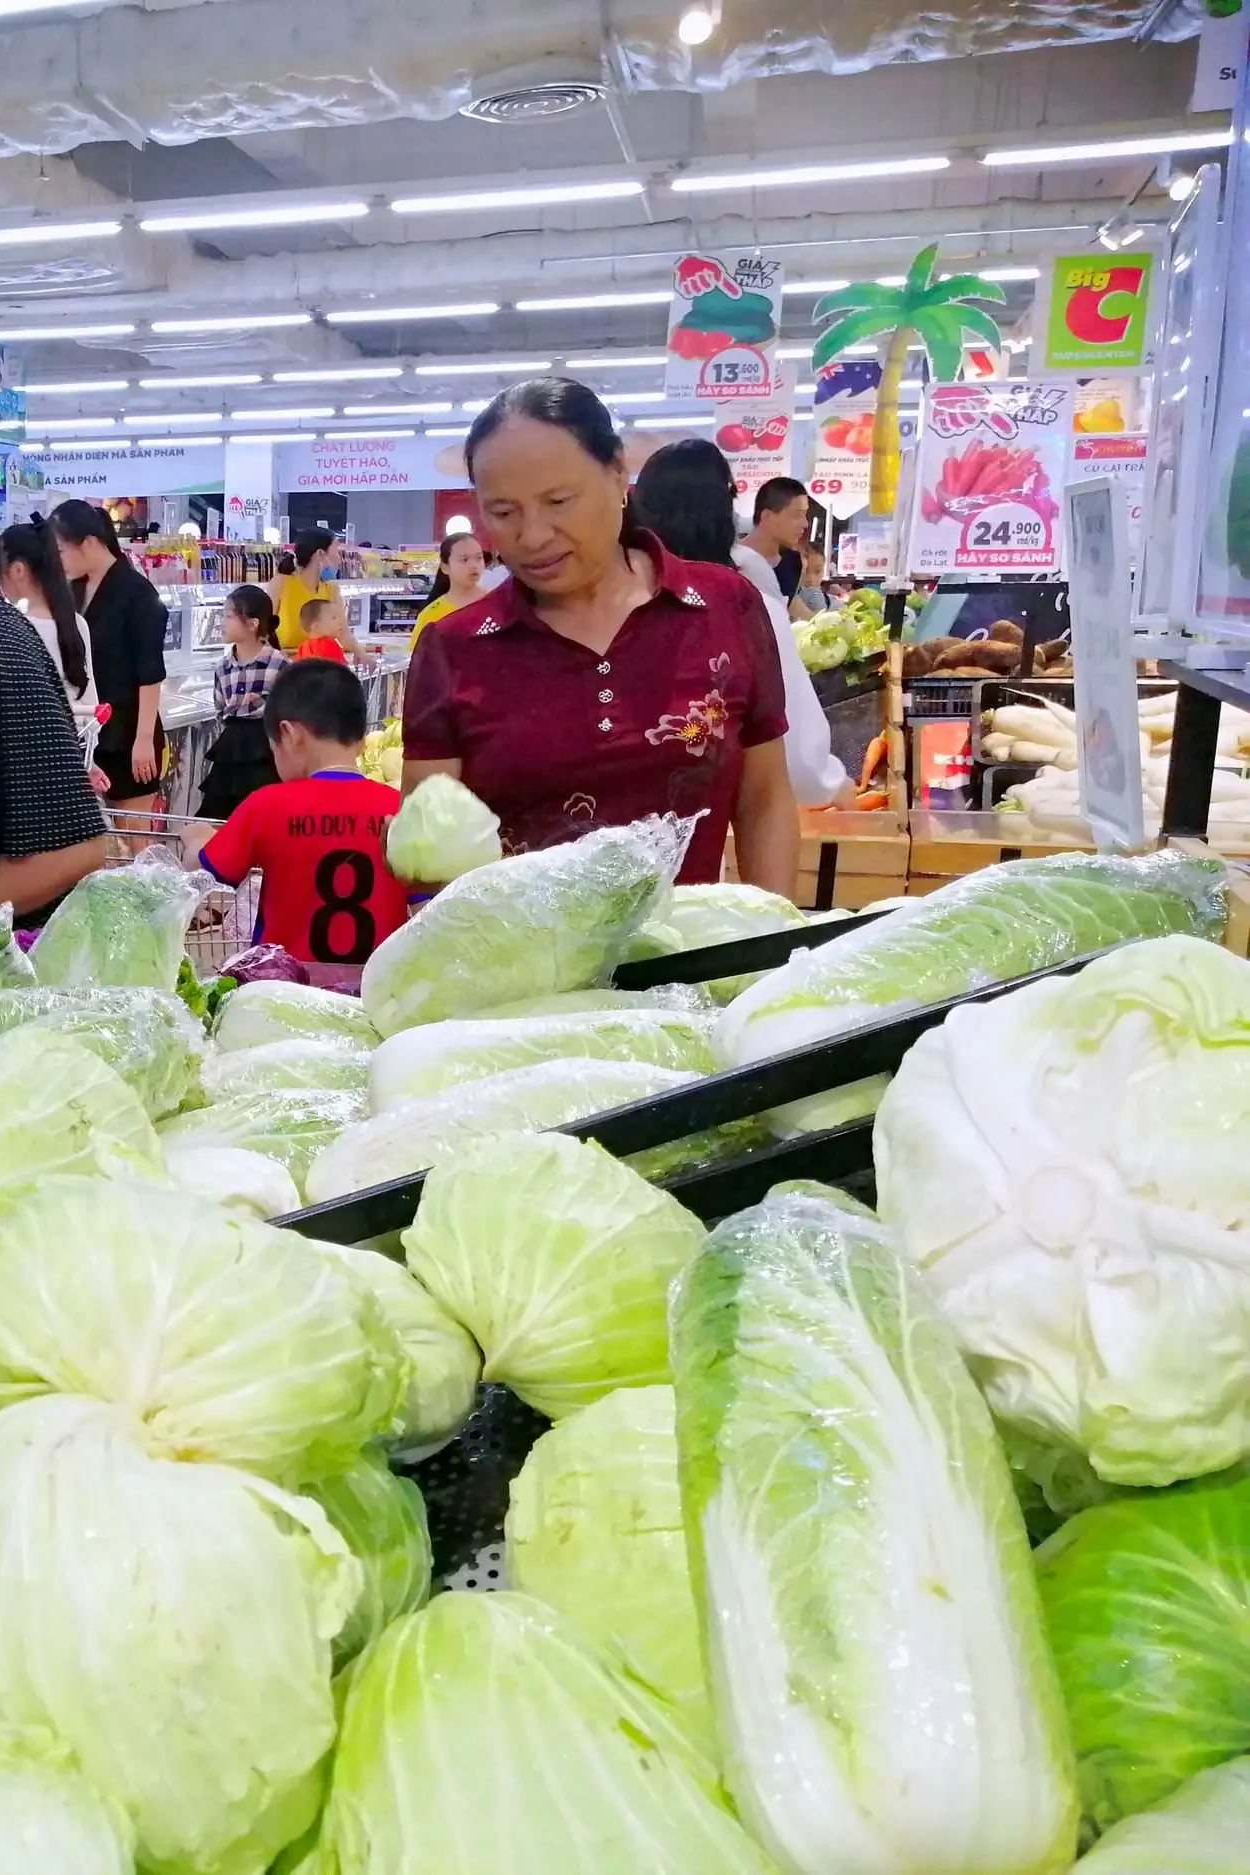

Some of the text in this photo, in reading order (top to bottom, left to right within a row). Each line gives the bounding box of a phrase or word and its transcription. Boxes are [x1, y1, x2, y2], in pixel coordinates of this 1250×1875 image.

[1066, 269, 1111, 292] Big
[1065, 266, 1145, 344] C
[810, 479, 843, 494] 69
[973, 521, 1041, 545] 24.900
[957, 550, 1052, 563] HÃY SO SÁNH
[321, 814, 358, 836] DUY
[309, 848, 376, 965] 8
